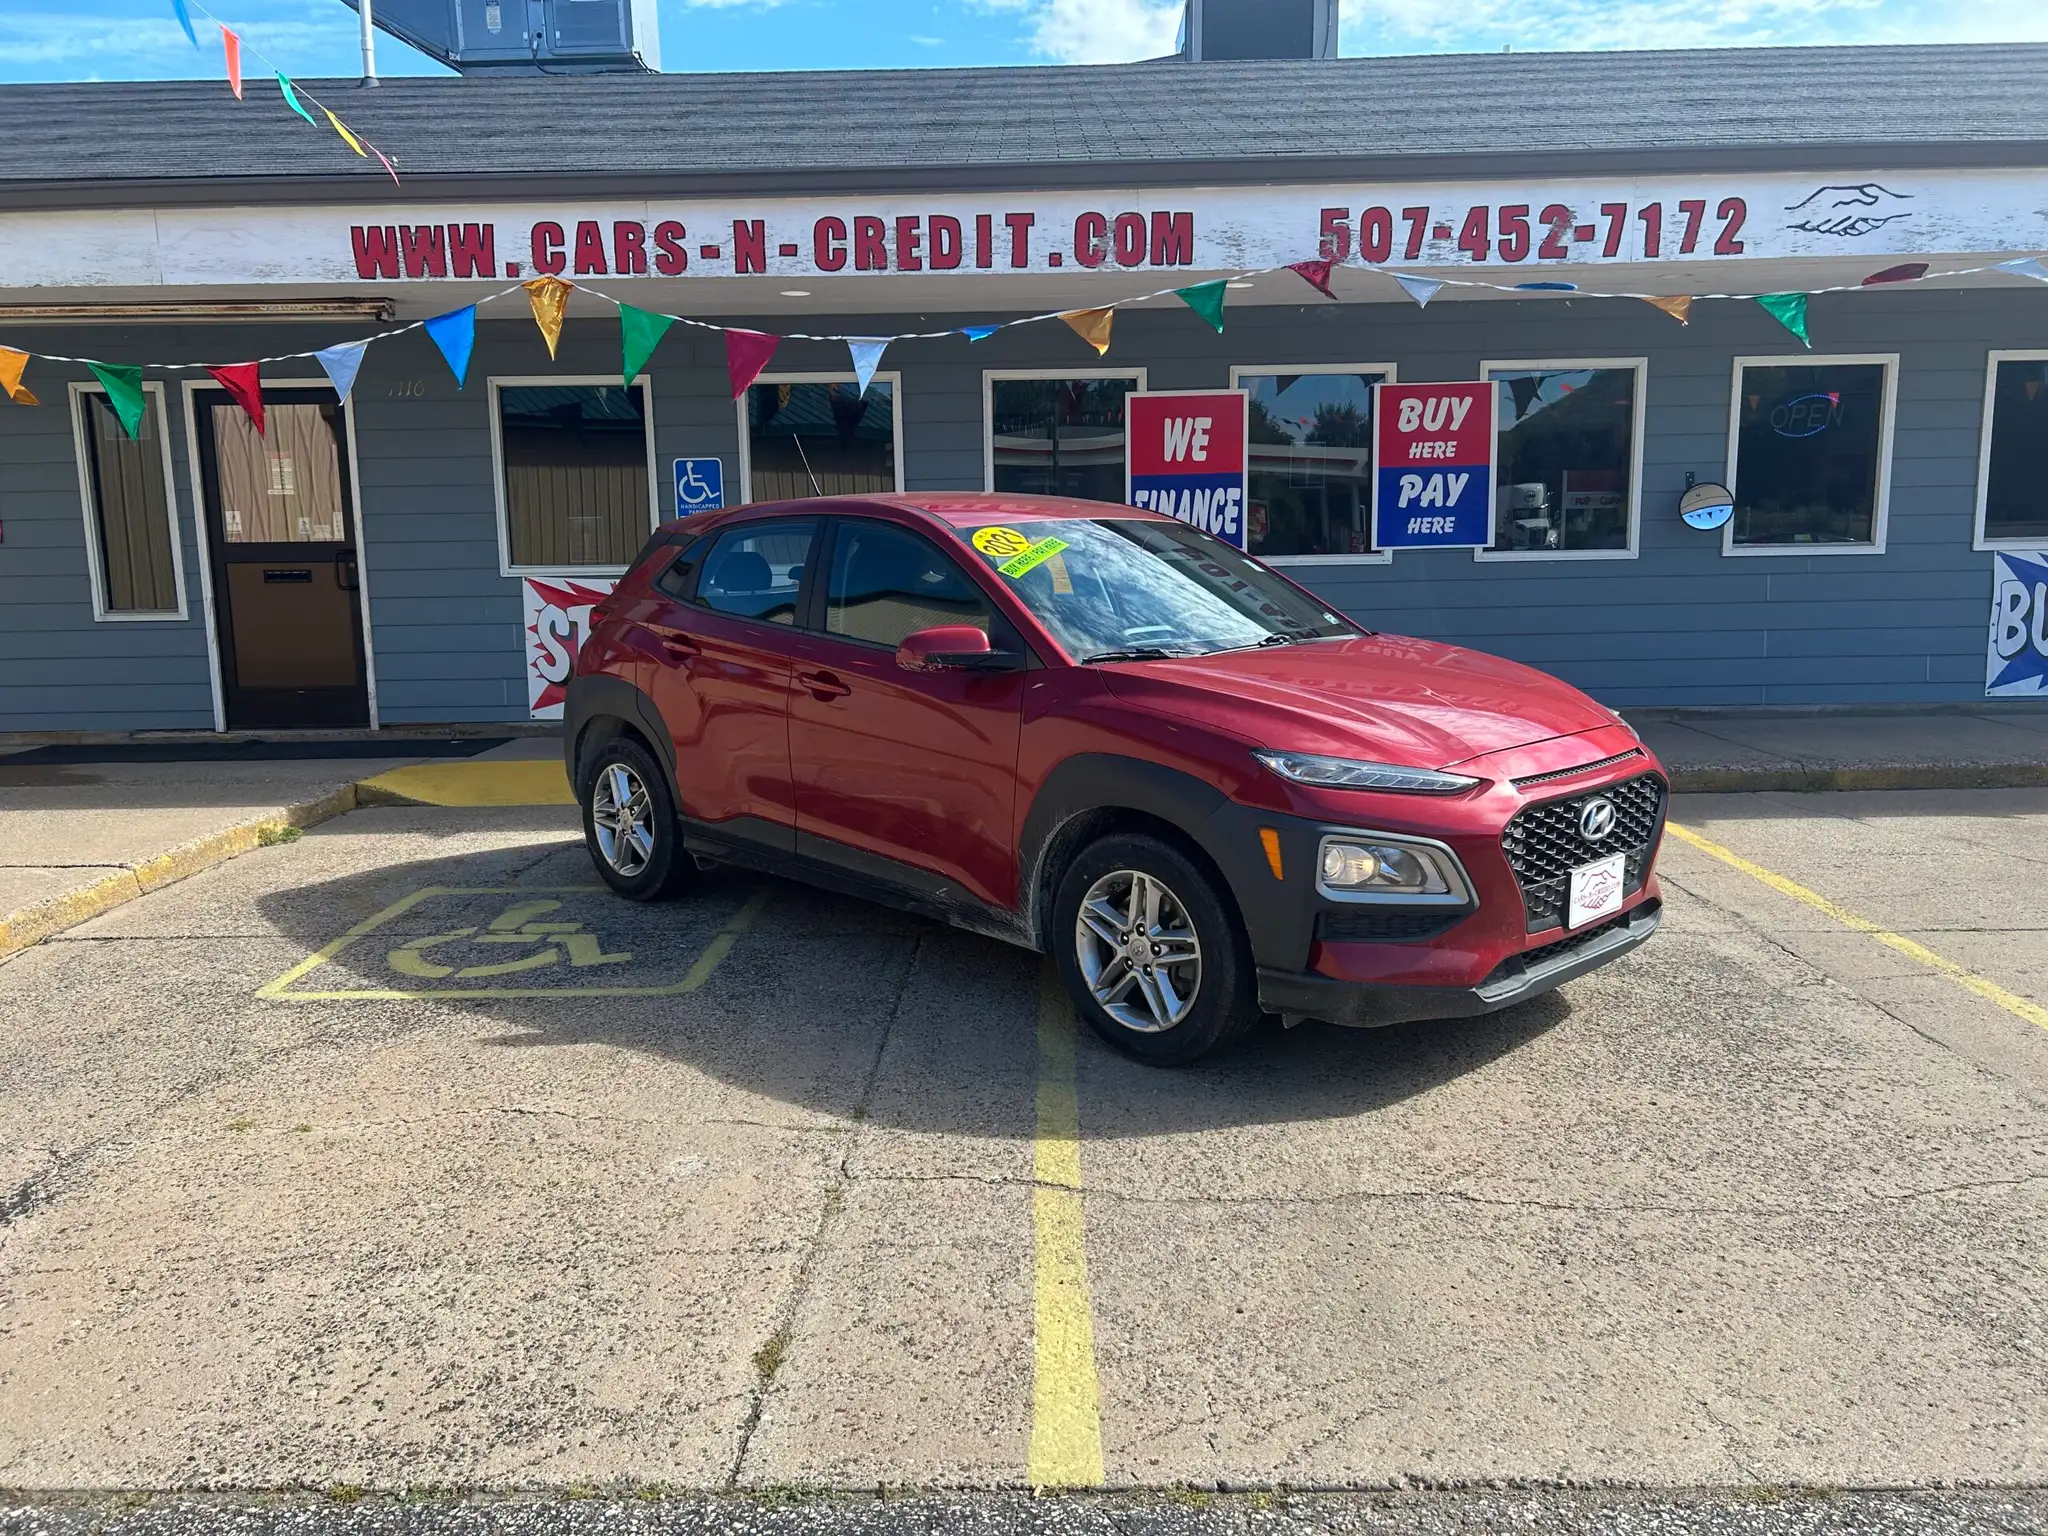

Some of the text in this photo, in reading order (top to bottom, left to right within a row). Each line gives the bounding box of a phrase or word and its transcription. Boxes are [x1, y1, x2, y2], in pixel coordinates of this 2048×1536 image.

[350, 196, 1747, 279] WWW.CARS-N-CREDIT.COM 507-452-7172
[1398, 396, 1473, 433] BUY
[1770, 403, 1845, 429] OPEN
[1164, 417, 1212, 462] WE
[1409, 441, 1457, 459] HERE
[1398, 473, 1469, 508] PAY
[1407, 517, 1455, 535] HERE
[983, 529, 1025, 555] 2021
